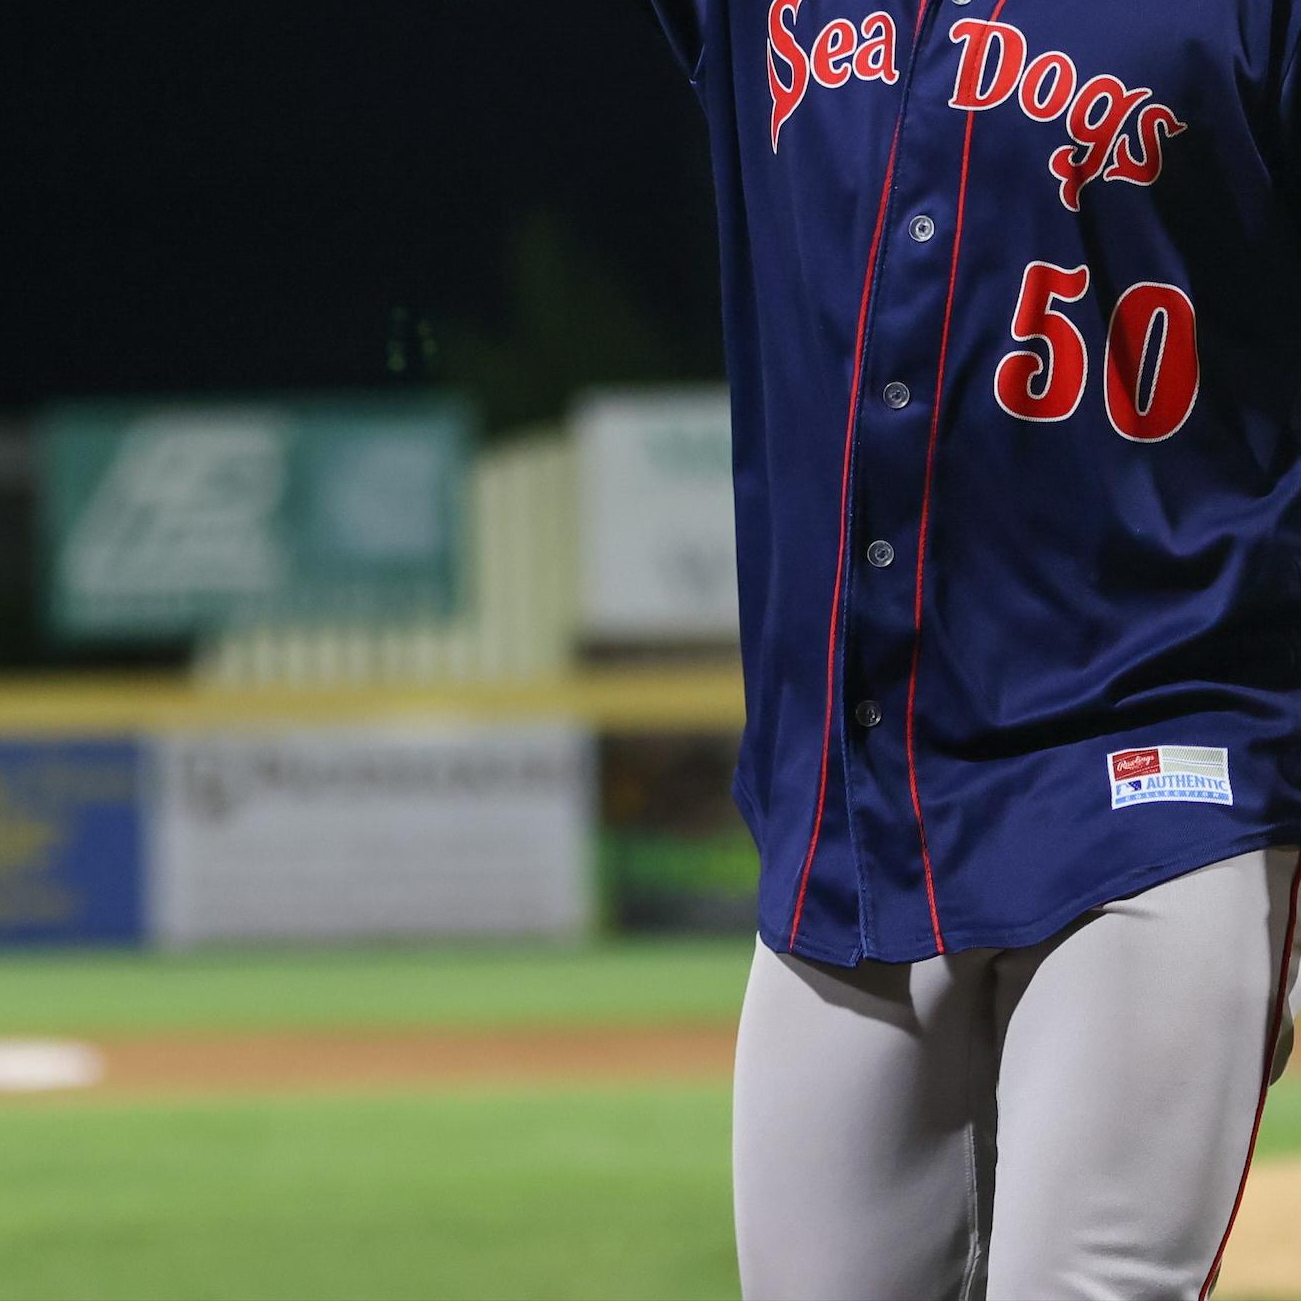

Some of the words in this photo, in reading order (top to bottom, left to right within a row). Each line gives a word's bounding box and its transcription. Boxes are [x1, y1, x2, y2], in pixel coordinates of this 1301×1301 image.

[949, 17, 1188, 212] Dogs
[994, 261, 1199, 443] 50
[1147, 775, 1228, 791] AUTHENTIC
